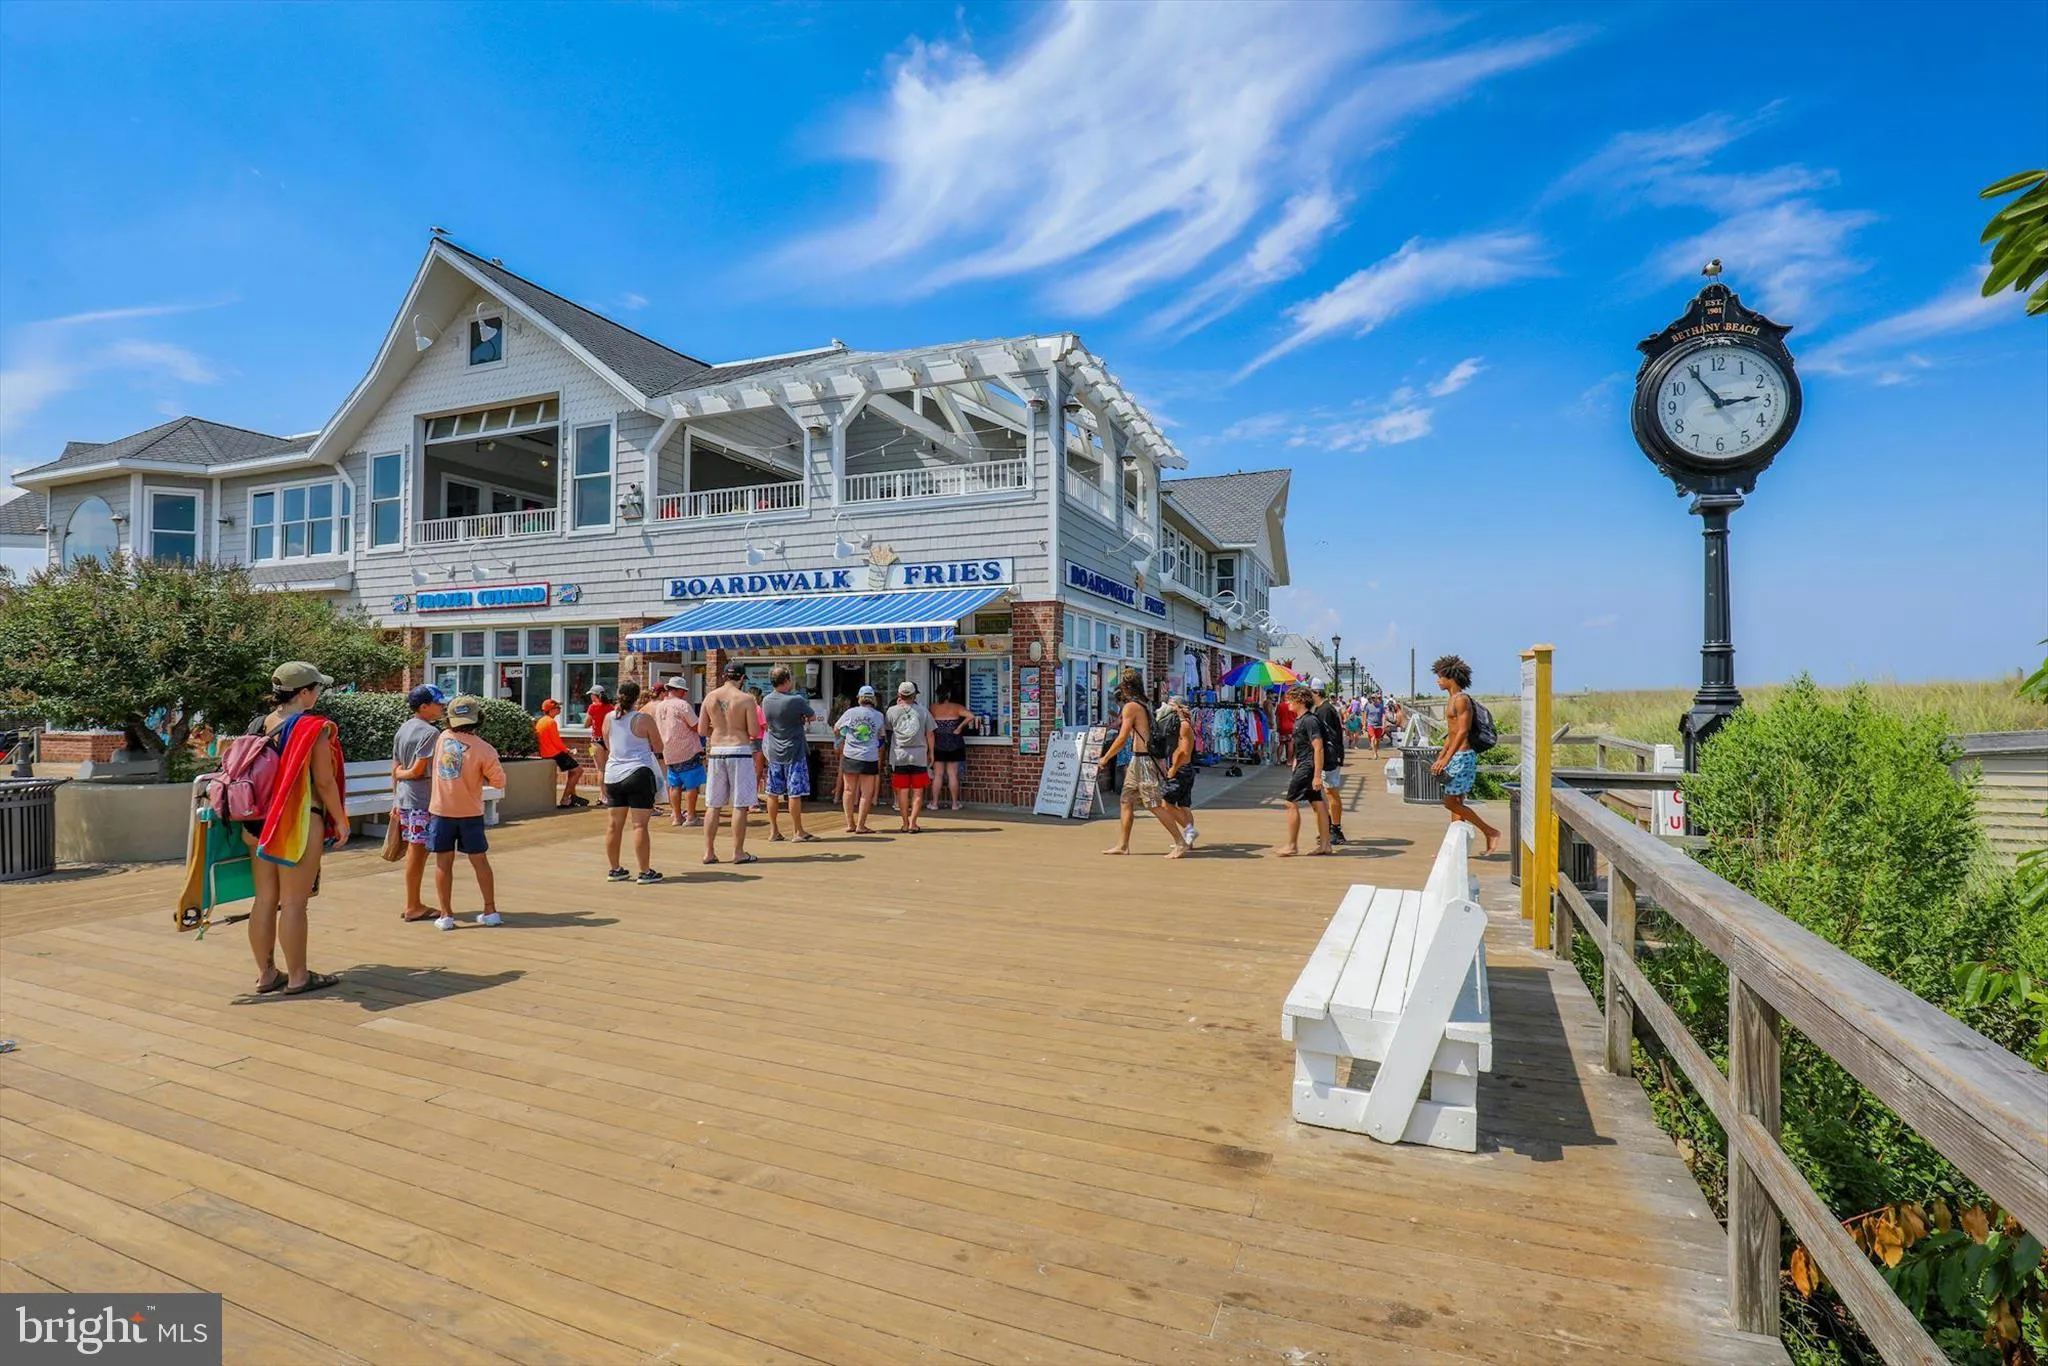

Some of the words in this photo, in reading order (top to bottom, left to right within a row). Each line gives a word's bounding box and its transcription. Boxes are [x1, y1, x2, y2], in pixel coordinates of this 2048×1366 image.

[1705, 299, 1723, 307] EST.
[1707, 307, 1722, 315] 1901
[1671, 322, 1720, 343] BETHANY
[1725, 322, 1760, 336] BEACH
[1711, 357, 1725, 371] 12
[1740, 361, 1745, 375] 1
[1672, 381, 1686, 396] 10
[1755, 374, 1764, 389] 2
[1668, 401, 1676, 415] 9
[1763, 393, 1771, 408] 3
[1674, 419, 1684, 434] 8
[1756, 412, 1766, 427] 4
[1690, 434, 1700, 448] 7
[1716, 437, 1724, 451] 6
[1740, 429, 1750, 444] 5
[670, 569, 851, 598] BOARDWALK
[903, 560, 1001, 586] FRIES
[415, 591, 473, 609] FROZEN
[477, 586, 547, 606] CUSTARD
[1071, 565, 1135, 605] BOARDWALK
[1145, 596, 1166, 616] FRIES
[1052, 750, 1075, 759] Coffee
